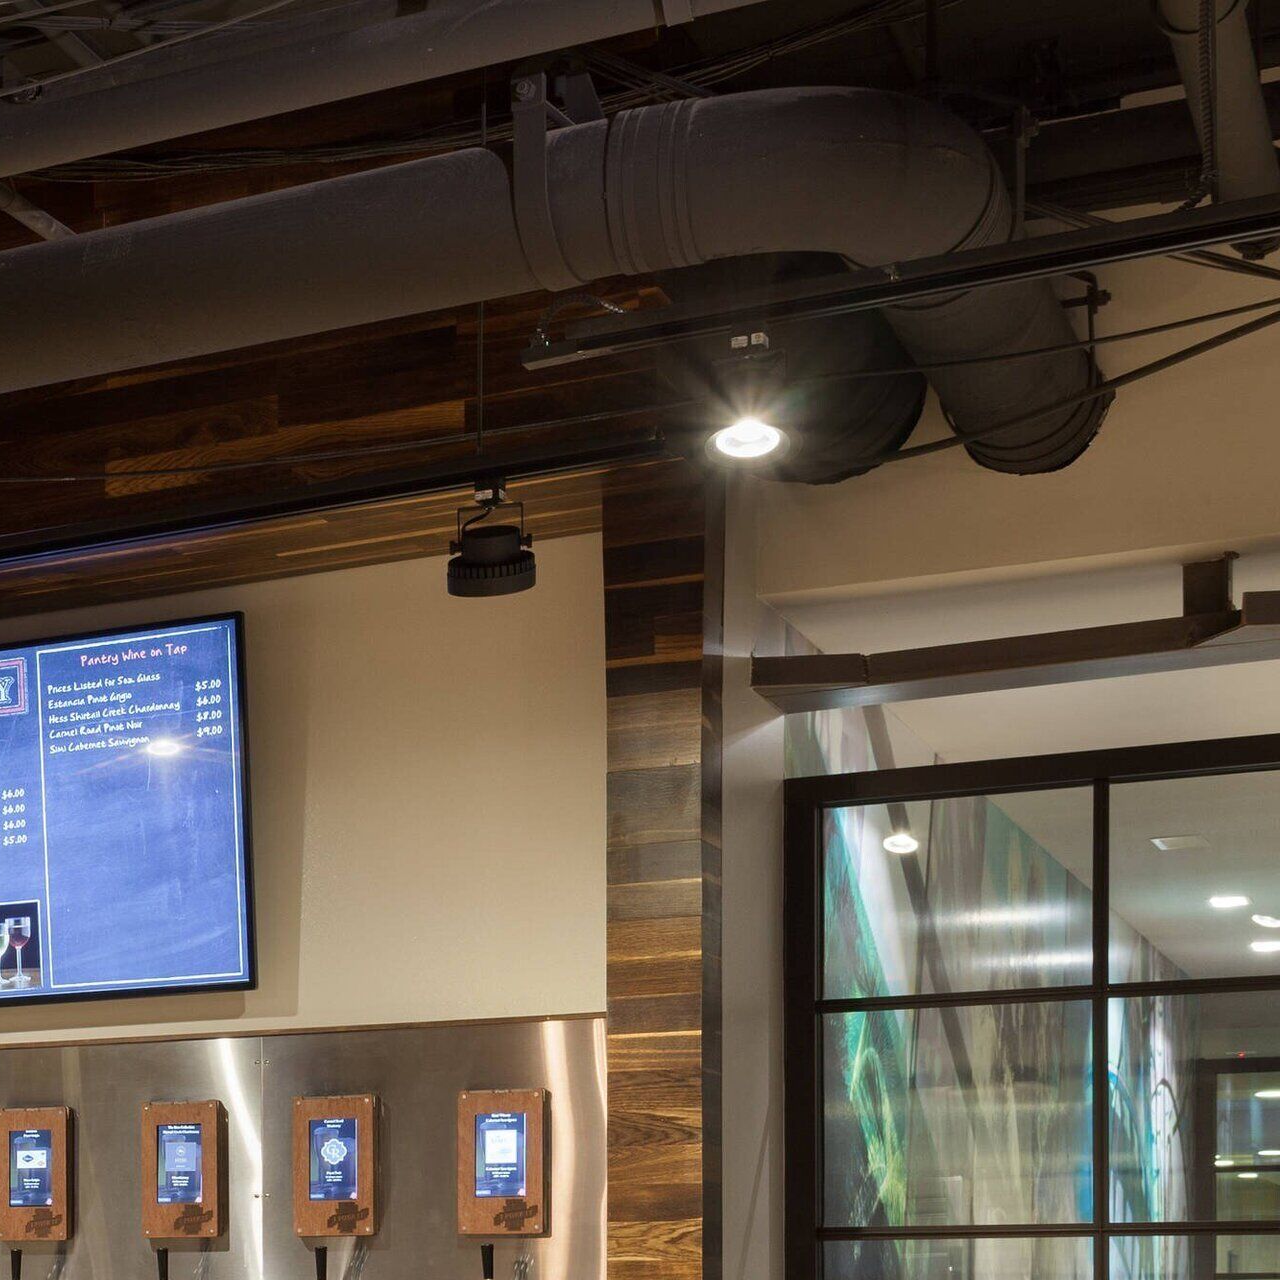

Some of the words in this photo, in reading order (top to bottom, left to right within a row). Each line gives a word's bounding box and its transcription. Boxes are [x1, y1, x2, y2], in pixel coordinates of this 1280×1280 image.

[81, 652, 118, 667] Pantry
[122, 650, 146, 662] Wine
[165, 644, 187, 655] Tap
[48, 685, 71, 694] Prices
[74, 681, 102, 691] Listed
[105, 678, 115, 687] for
[137, 673, 160, 682] Glass
[195, 679, 221, 692] $5.00
[48, 699, 85, 709] Estancia
[87, 695, 108, 704] Pinot
[110, 692, 132, 703] Grigio
[196, 695, 221, 707] $6.00
[49, 715, 68, 724] Hess
[102, 708, 126, 718] Creek
[129, 702, 181, 714] Chardonnay
[196, 710, 222, 722] $8.00
[49, 730, 78, 739] Carmel
[80, 725, 101, 735] Road
[104, 723, 124, 732] Pinot
[126, 721, 143, 730] Noir
[196, 725, 222, 738] $9.00
[68, 740, 106, 752] Cabernet
[108, 736, 150, 748] Sauvignon
[1, 788, 25, 800] $6.00
[2, 805, 25, 815] $6.00
[3, 820, 26, 831] $6.00
[3, 835, 27, 846] $5.00
